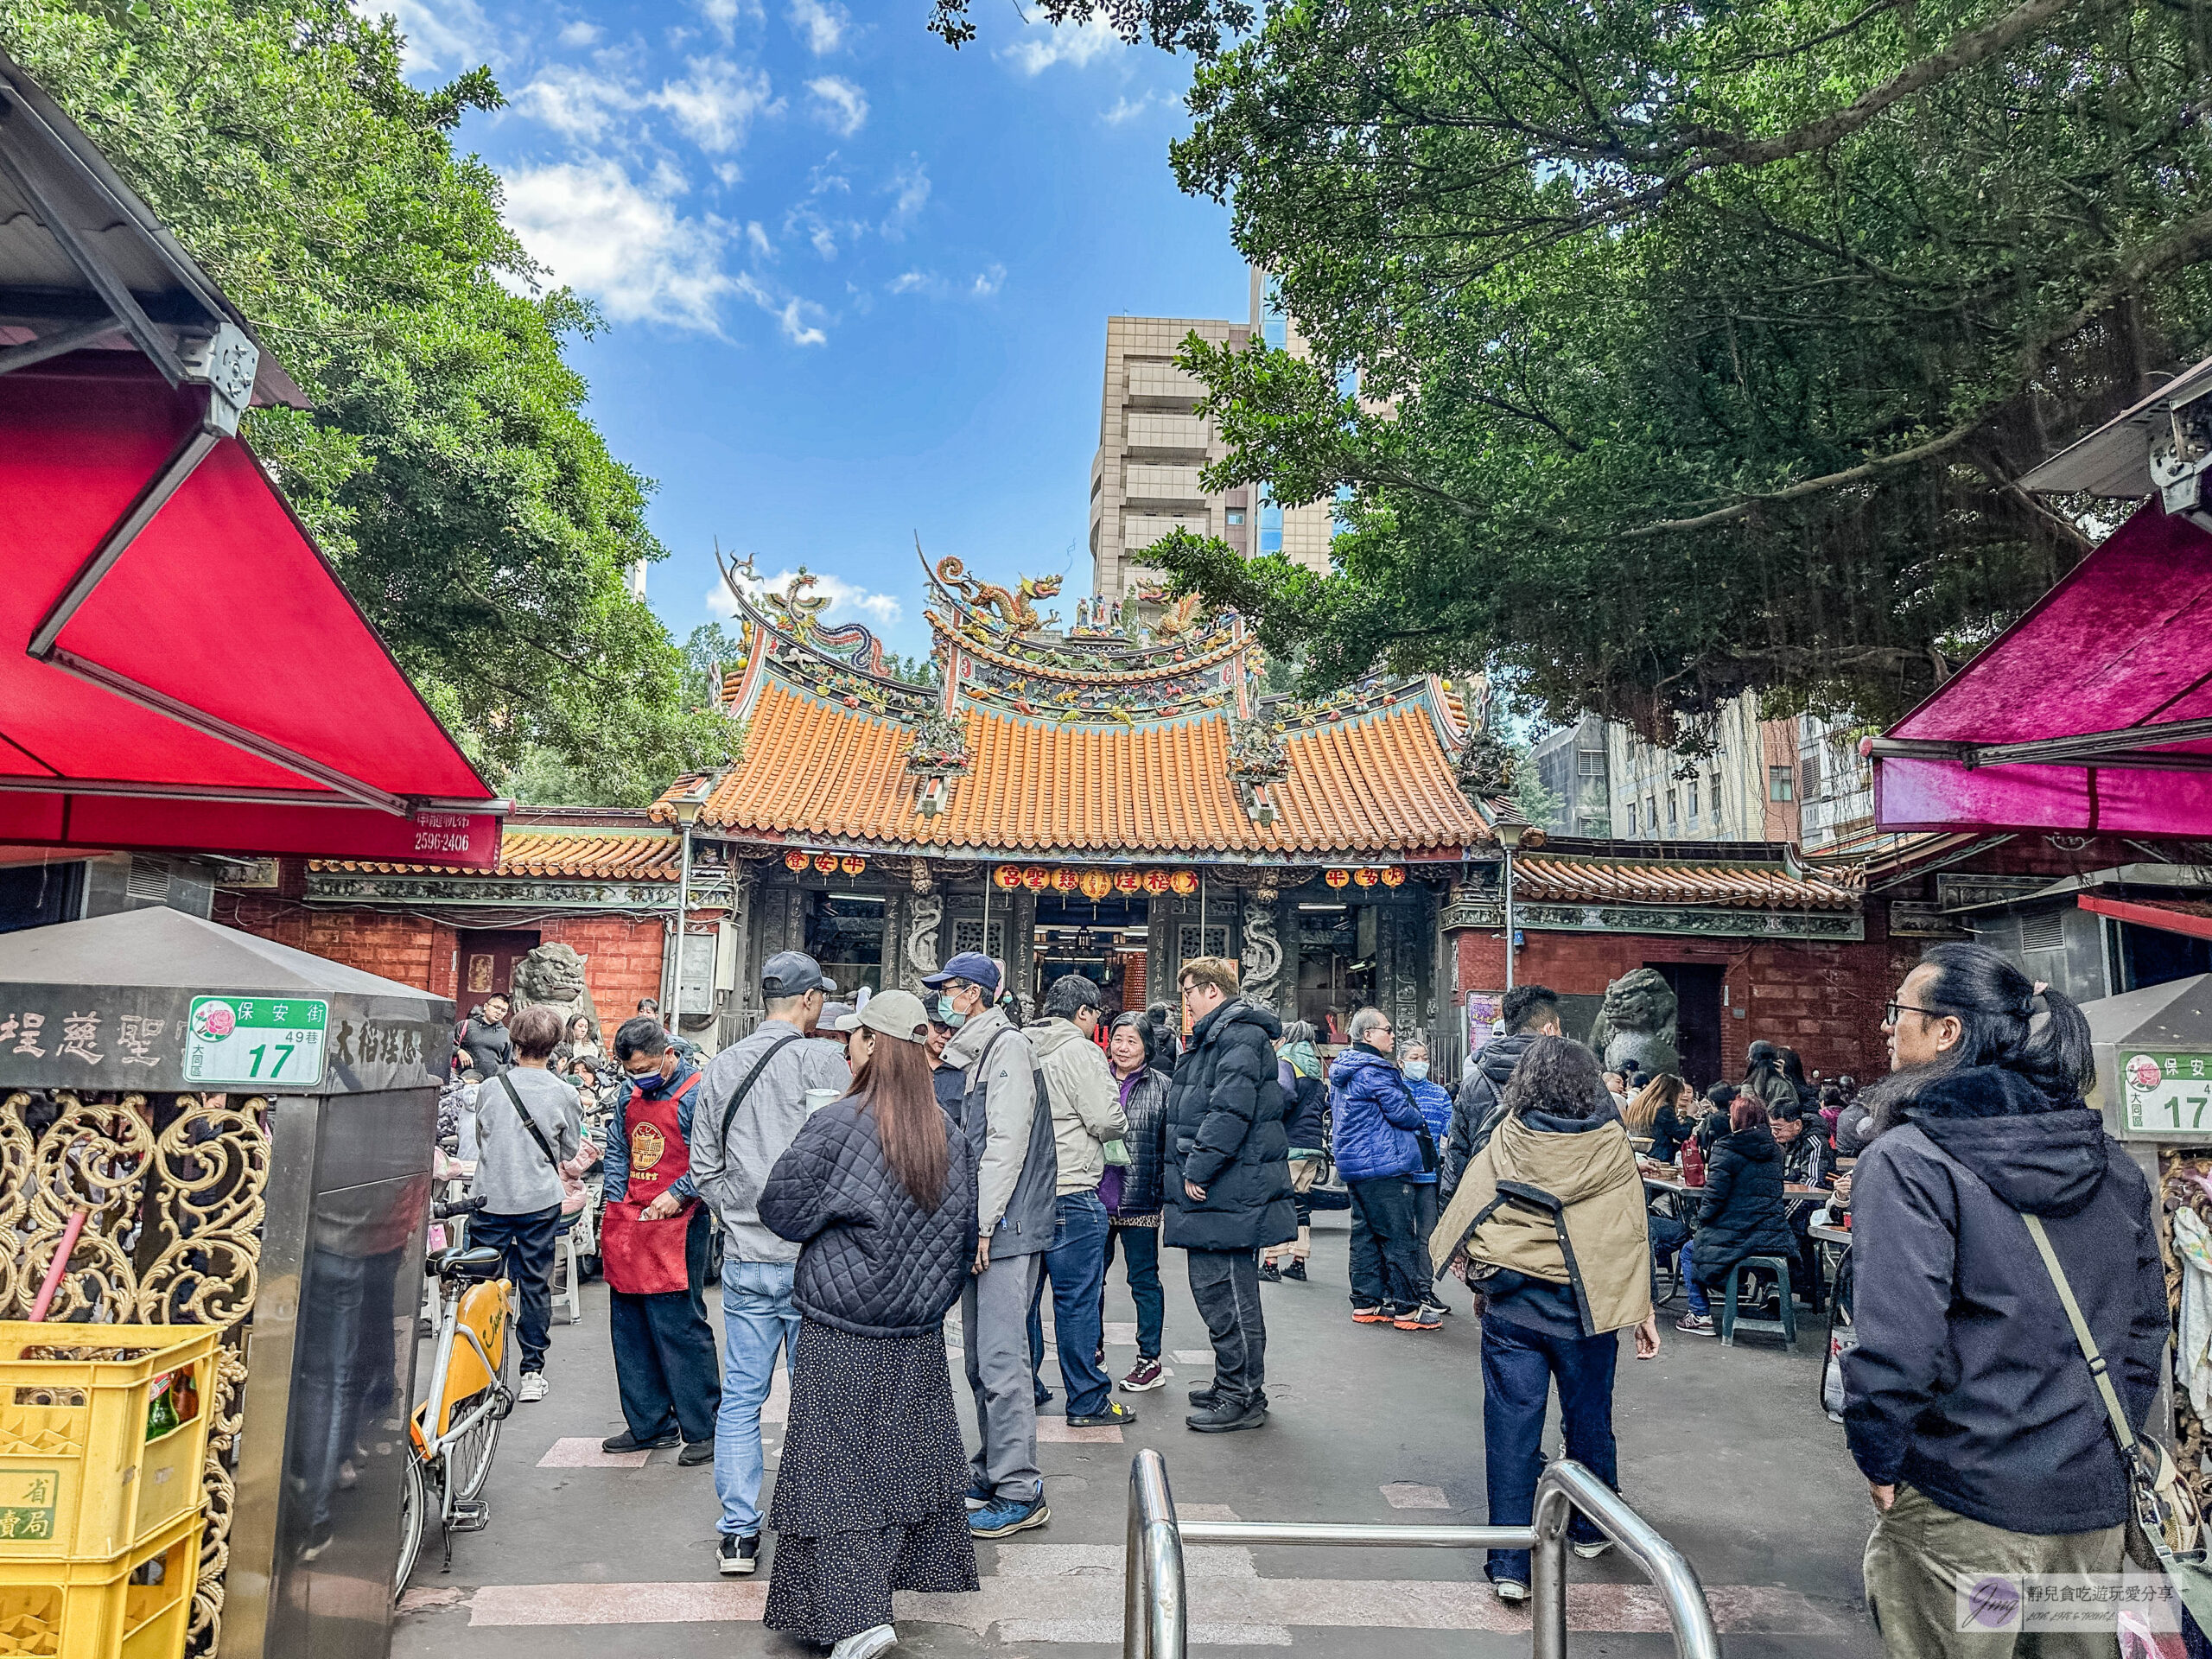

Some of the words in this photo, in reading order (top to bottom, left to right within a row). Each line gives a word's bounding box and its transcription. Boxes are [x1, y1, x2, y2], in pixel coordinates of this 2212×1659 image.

[415, 832, 470, 852] 2596-2406
[238, 1001, 324, 1023] 保安街
[285, 1031, 319, 1044] 49巷
[191, 1044, 205, 1077] 大同區
[249, 1044, 295, 1078] 17
[2164, 1058, 2205, 1077] 保安
[2131, 1092, 2144, 1128] 大同區
[2164, 1096, 2208, 1128] 17
[22, 1478, 49, 1504] 省
[0, 1509, 49, 1538] 賣局
